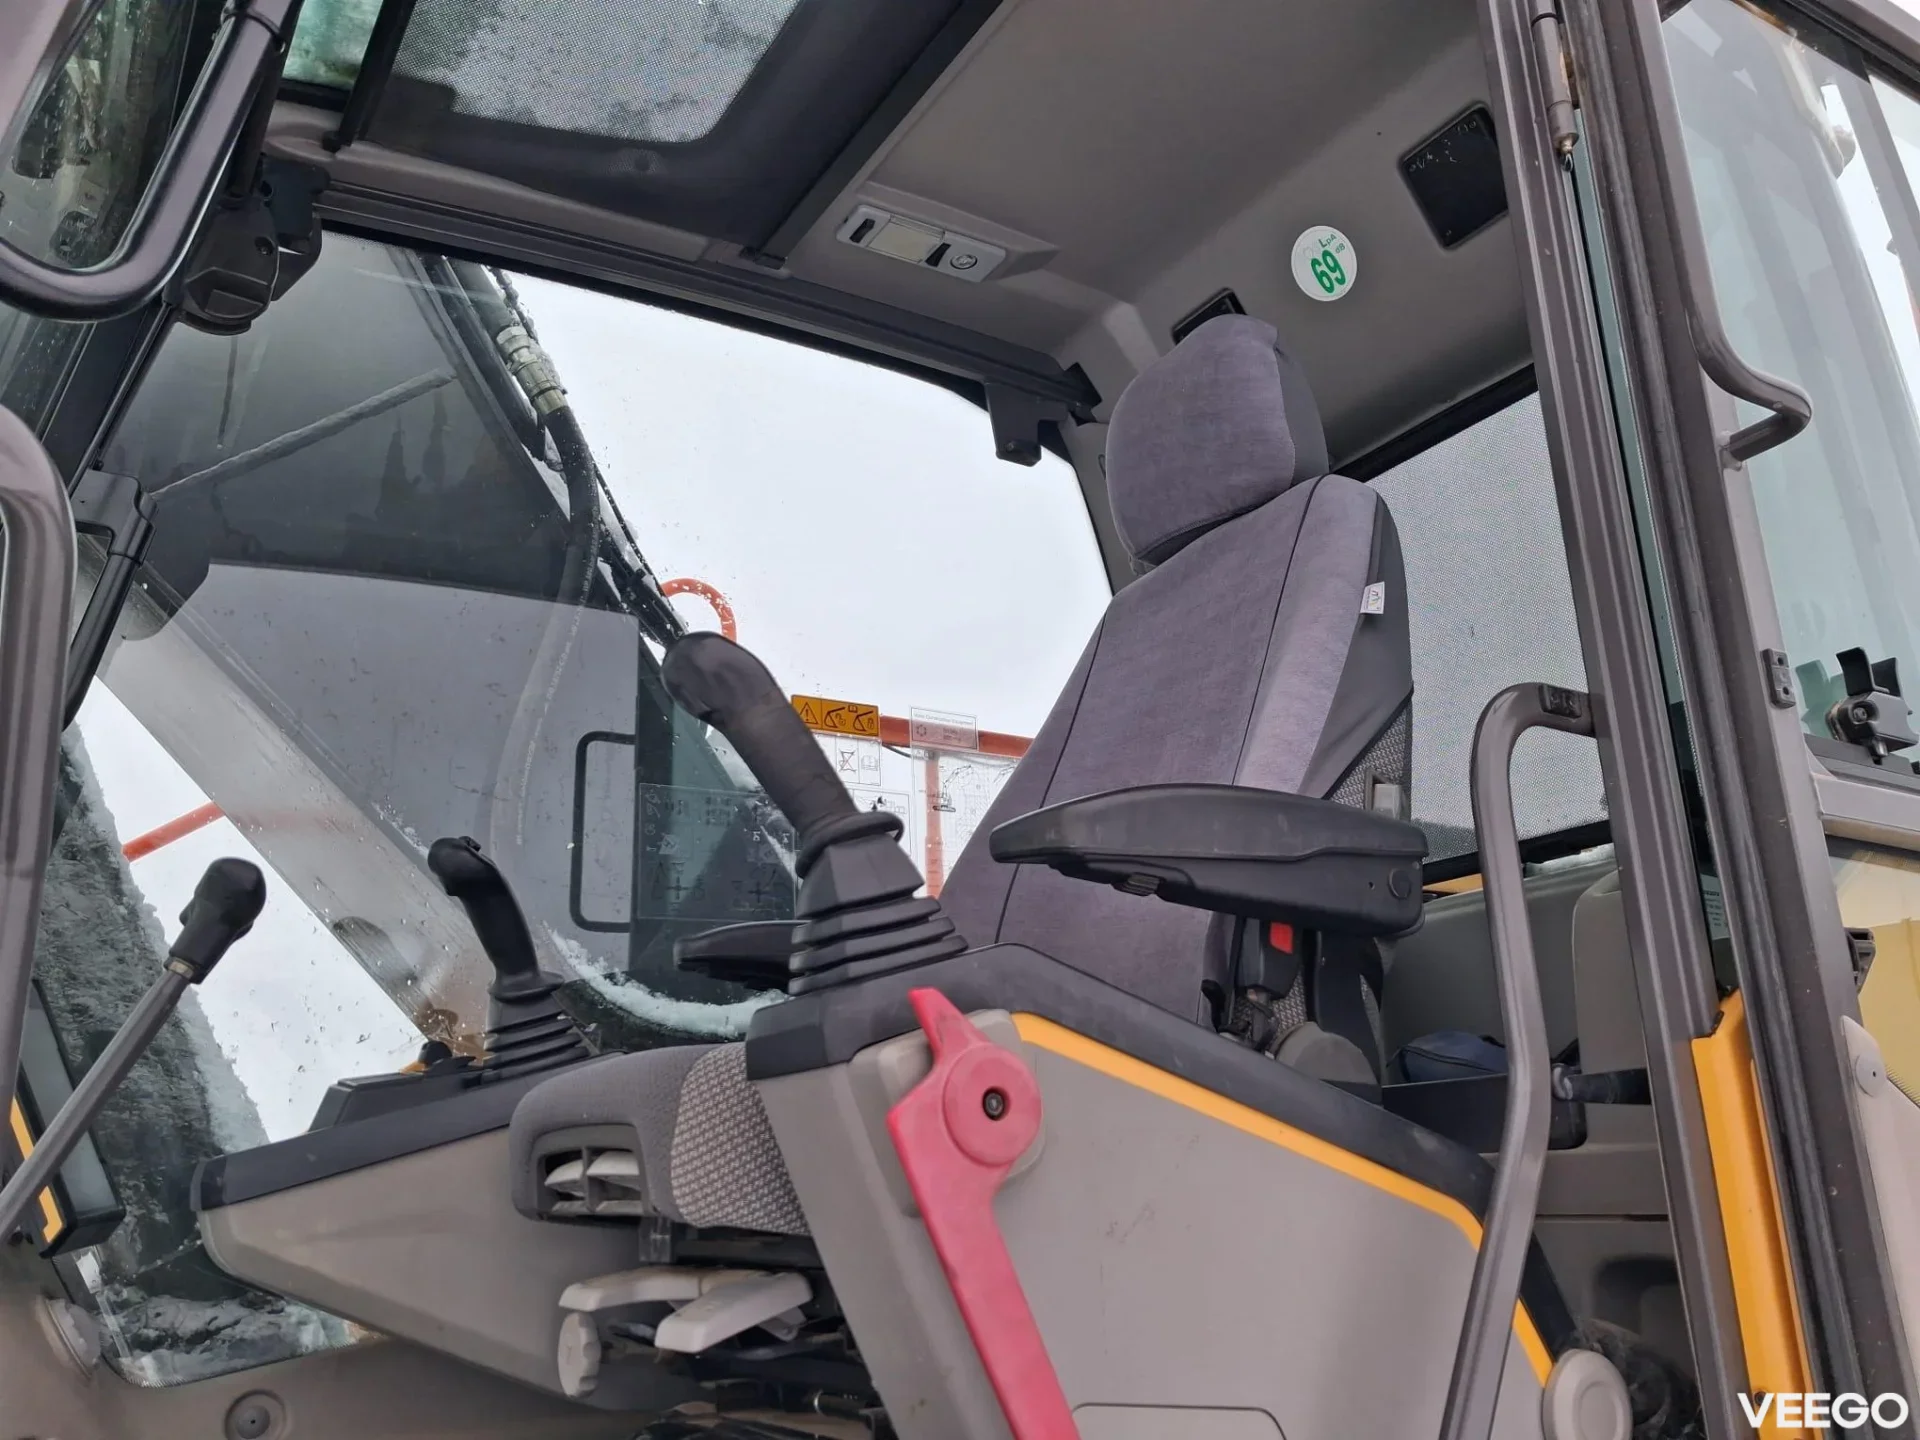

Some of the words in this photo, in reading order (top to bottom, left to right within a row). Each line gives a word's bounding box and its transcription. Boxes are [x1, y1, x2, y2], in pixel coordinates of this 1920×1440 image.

[1318, 233, 1337, 248] LpA
[1335, 242, 1346, 254] dB
[1310, 249, 1346, 294] 69
